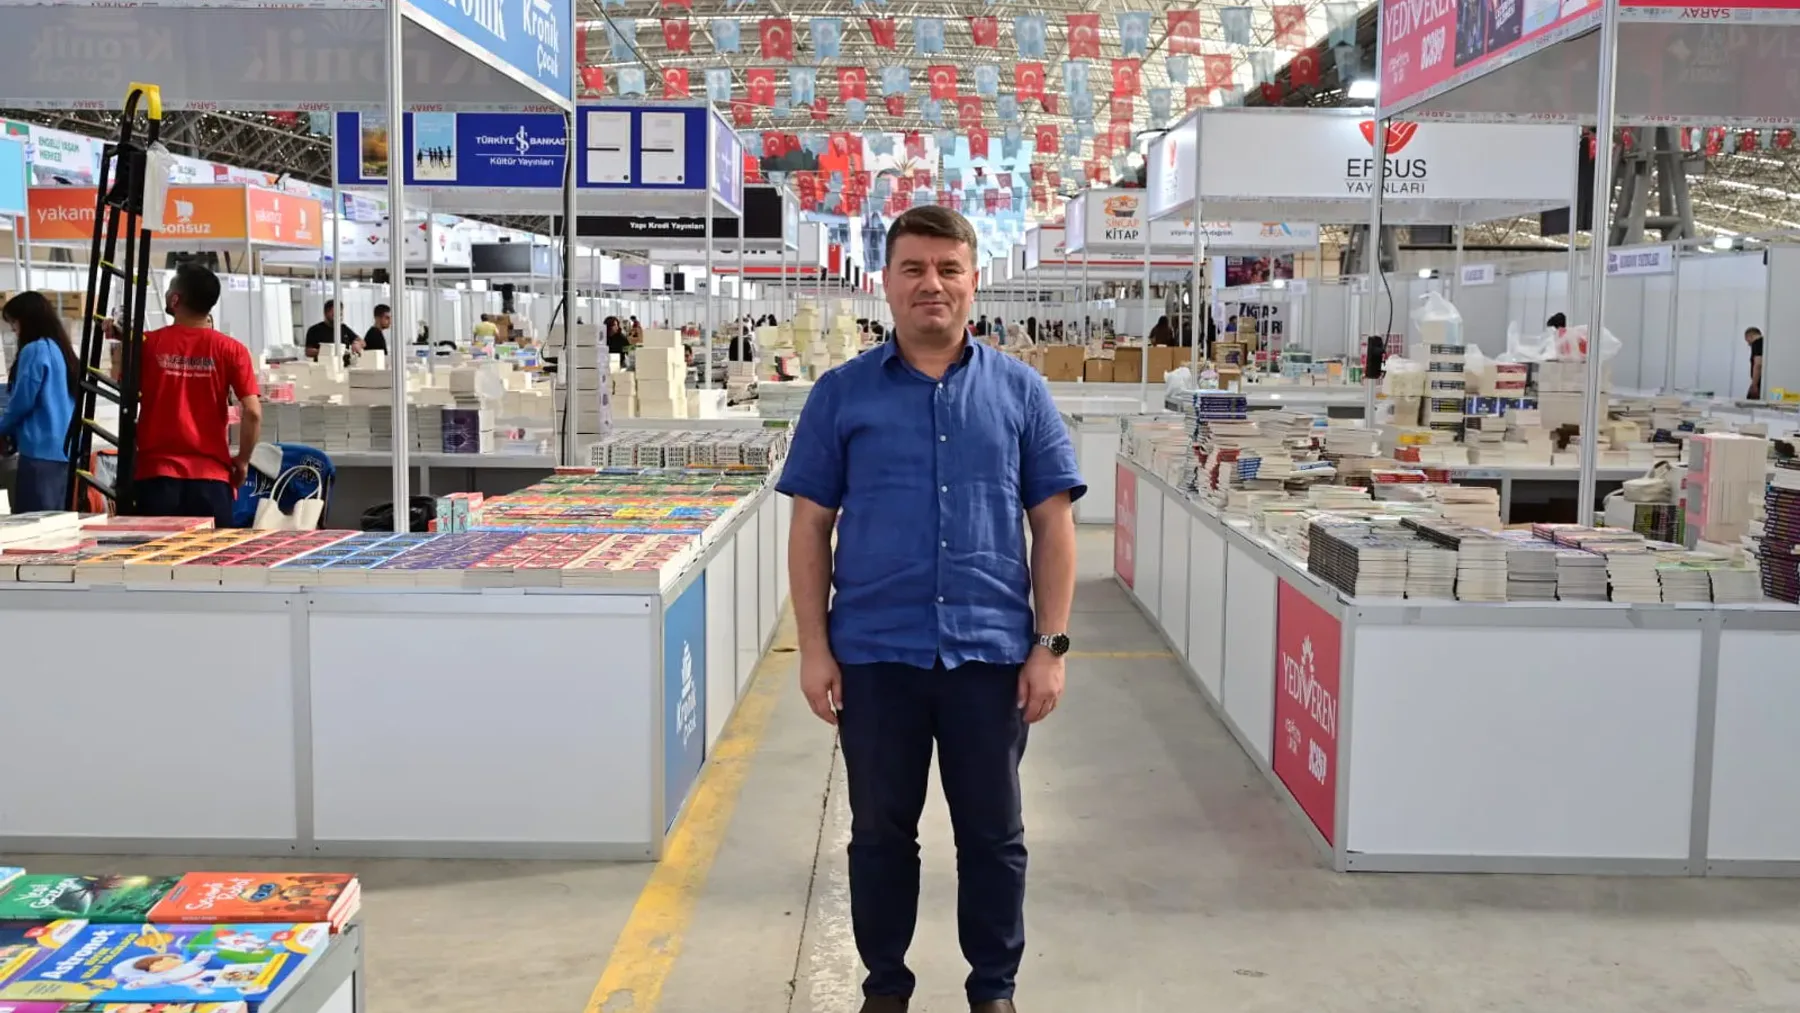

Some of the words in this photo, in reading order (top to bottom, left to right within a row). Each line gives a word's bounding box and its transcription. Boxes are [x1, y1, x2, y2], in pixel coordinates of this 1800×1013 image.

[1679, 8, 1731, 19] SARAY
[523, 0, 559, 53] Kronik
[537, 43, 558, 78] Çocuk
[475, 135, 515, 145] TÜRKİYE
[529, 137, 566, 146] BANKAS
[489, 157, 517, 166] Kültür
[517, 158, 554, 167] Yayınları
[1346, 182, 1425, 194] YAYNLARI
[630, 221, 647, 230] Yapı
[648, 221, 669, 230] Kredi
[1105, 228, 1139, 240] KİTAP
[40, 929, 116, 979] Astronot
